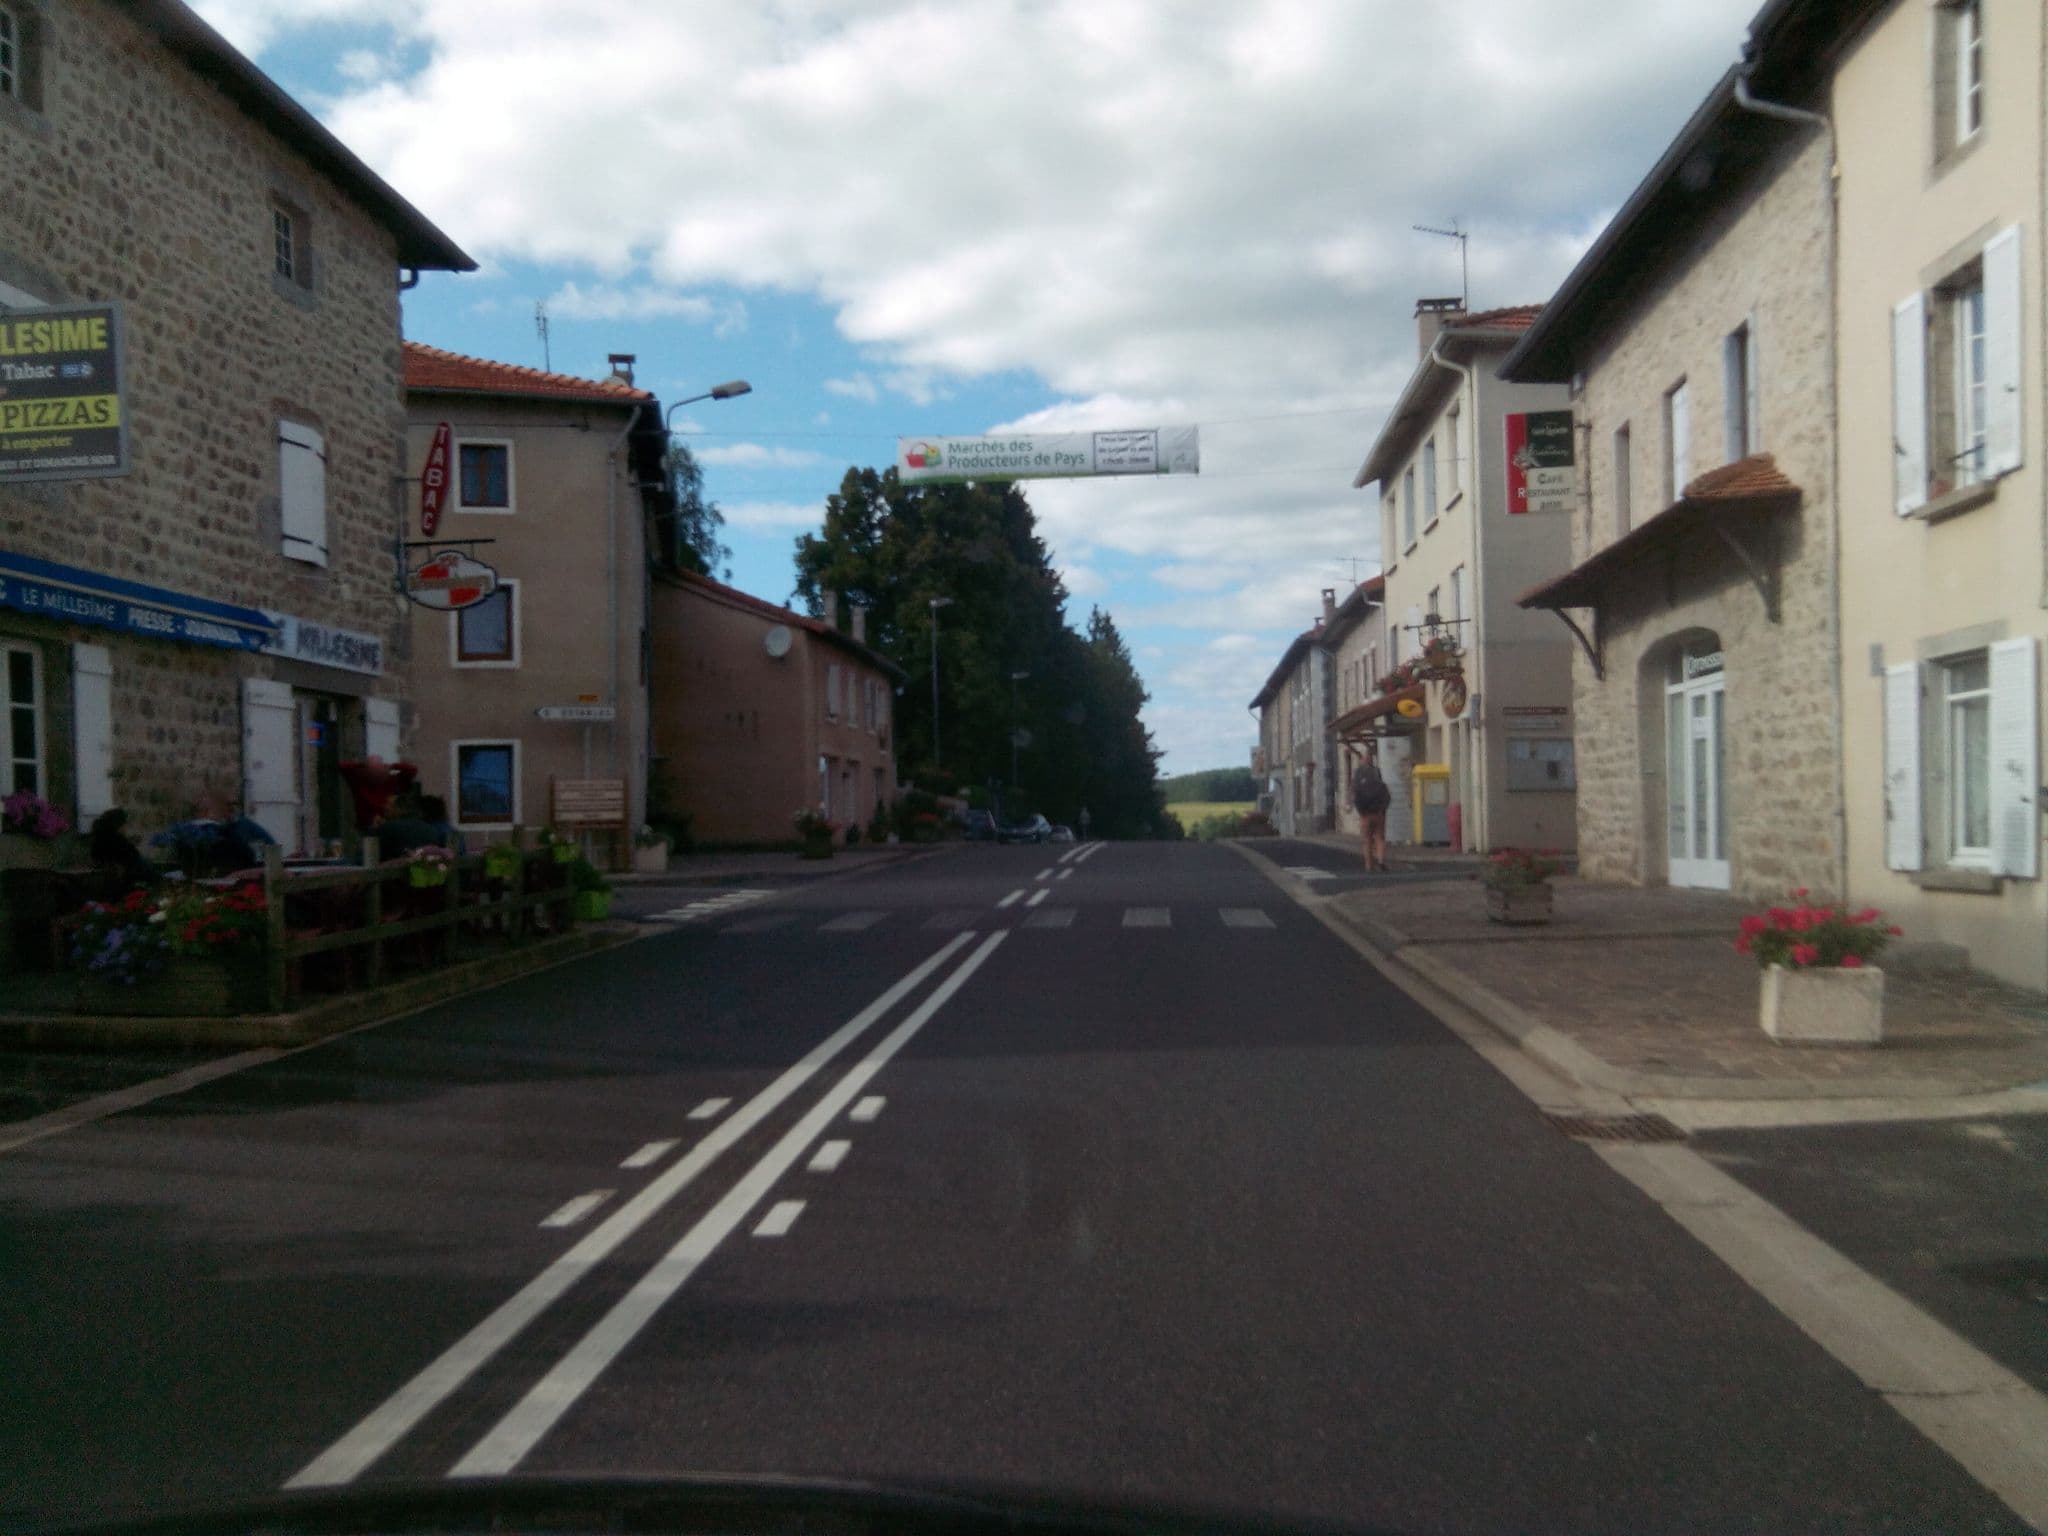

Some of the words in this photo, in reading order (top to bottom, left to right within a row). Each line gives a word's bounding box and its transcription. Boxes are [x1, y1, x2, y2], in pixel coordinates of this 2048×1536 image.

[2, 362, 56, 381] Tabac
[3, 399, 110, 429] PIZZAS
[948, 440, 1005, 455] Marchés
[1010, 440, 1034, 453] des
[948, 454, 1031, 469] Producteurs
[1034, 453, 1051, 465] de
[1055, 452, 1085, 467] Pays
[423, 425, 449, 529] TABAC
[22, 586, 39, 606] LE
[127, 607, 174, 633] PRESSE
